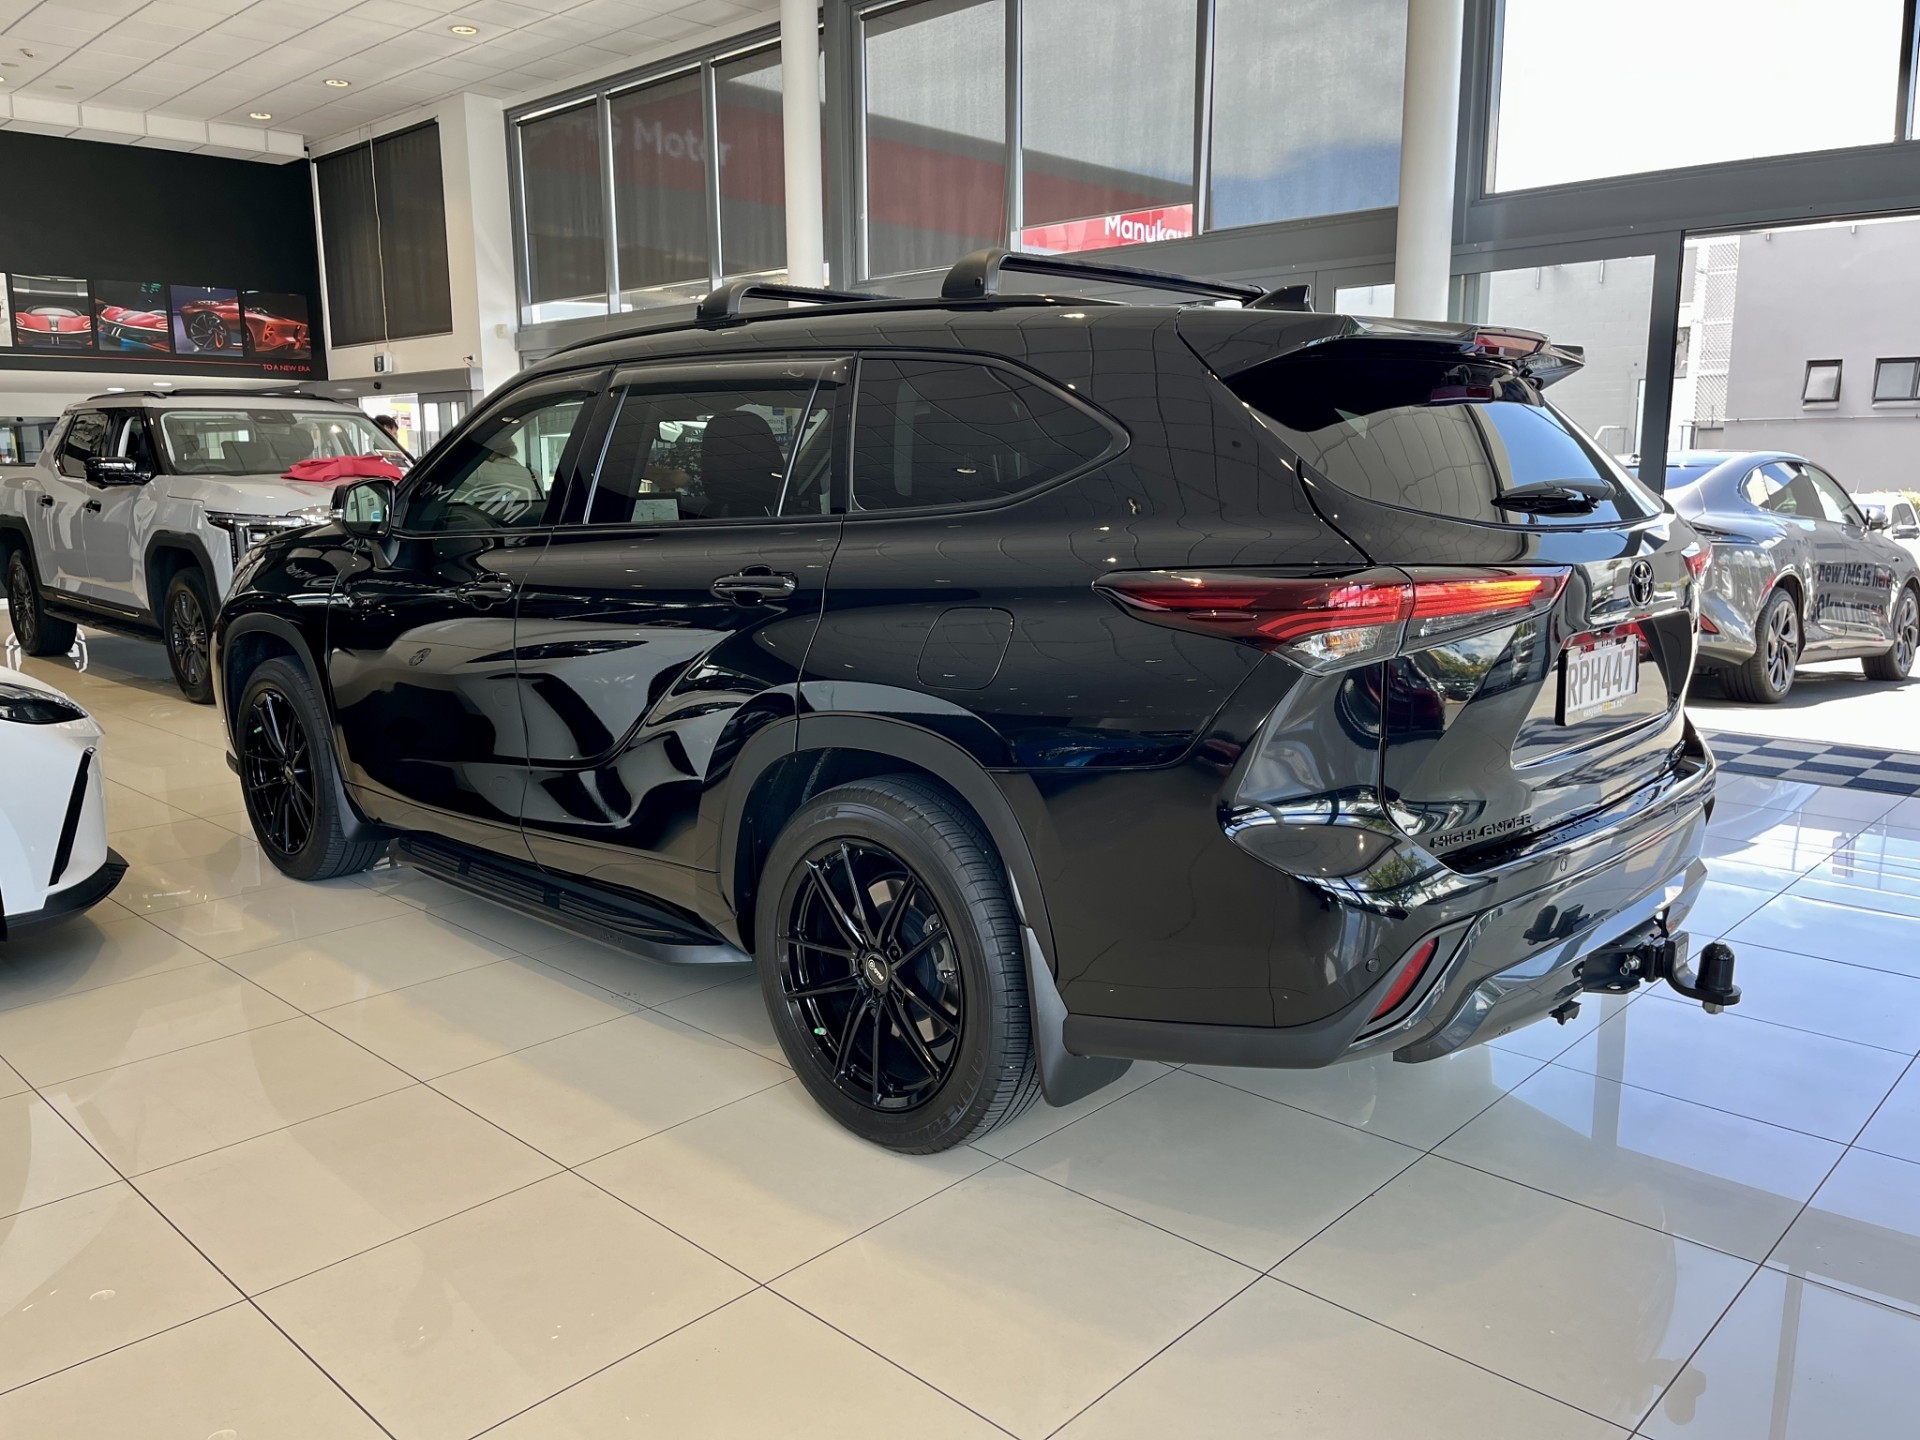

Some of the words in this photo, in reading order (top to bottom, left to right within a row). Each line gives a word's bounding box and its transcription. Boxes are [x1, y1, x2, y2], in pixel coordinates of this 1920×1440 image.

[633, 116, 731, 167] Motr
[263, 363, 273, 371] TO
[280, 364, 297, 372] NEW
[1817, 564, 1842, 583] new
[1862, 563, 1871, 587] is
[1567, 649, 1634, 708] RPH447
[1430, 813, 1532, 848] HIGHLANDER
